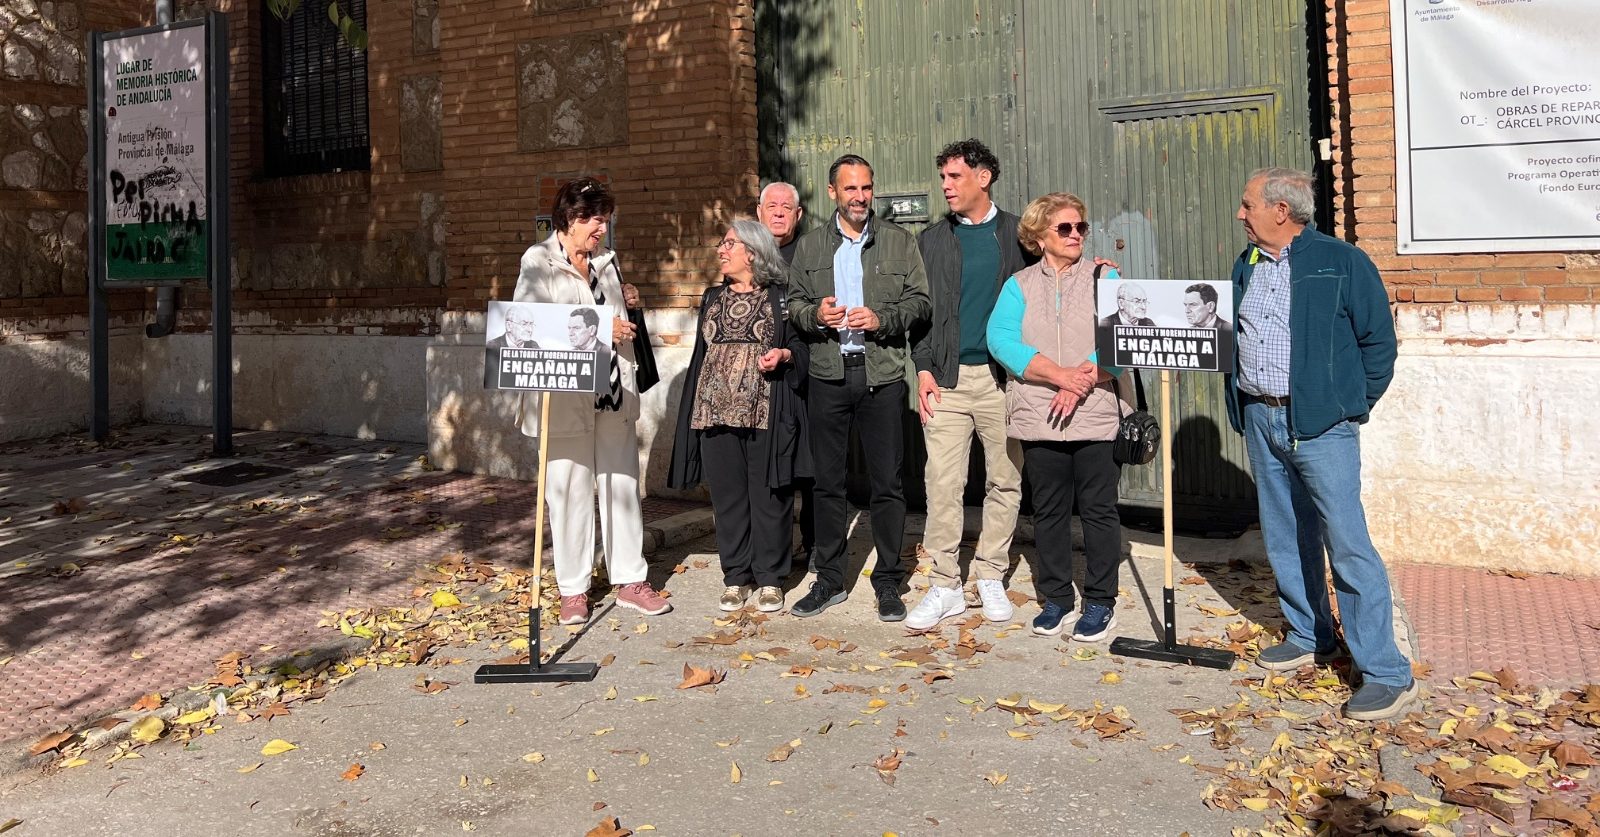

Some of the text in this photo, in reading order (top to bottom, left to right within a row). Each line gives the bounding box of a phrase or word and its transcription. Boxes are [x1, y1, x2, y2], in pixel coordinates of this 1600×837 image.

[1414, 6, 1460, 16] Ayuntamiento
[1430, 14, 1454, 22] Málaga
[116, 58, 153, 75] LUGAR DE
[116, 67, 197, 91] MEMORIA HISTÓRICA
[116, 85, 172, 107] DE ANDALUCÍA
[1460, 83, 1592, 100] Nombre del Proyecto:
[1496, 104, 1537, 117] OBRAS
[1541, 103, 1557, 113] DE
[1496, 117, 1542, 129] CÁRCEL
[117, 131, 144, 145] Antigua
[118, 142, 194, 160] Provincial de Málaga
[1527, 156, 1573, 166] Proyecto
[1507, 171, 1557, 181] Programa
[1539, 183, 1575, 194] (Fondo
[1117, 328, 1215, 339] DE LA TORRE Y MORENO BONILLA
[1118, 337, 1214, 354] ENGAÑAN A
[503, 350, 594, 361] DE LA TORRE Y MORENO BONILLA
[1132, 351, 1200, 367] MÁLAGA
[502, 360, 592, 376] ENGAÑAN A
[515, 373, 578, 388] MÁLAGA
